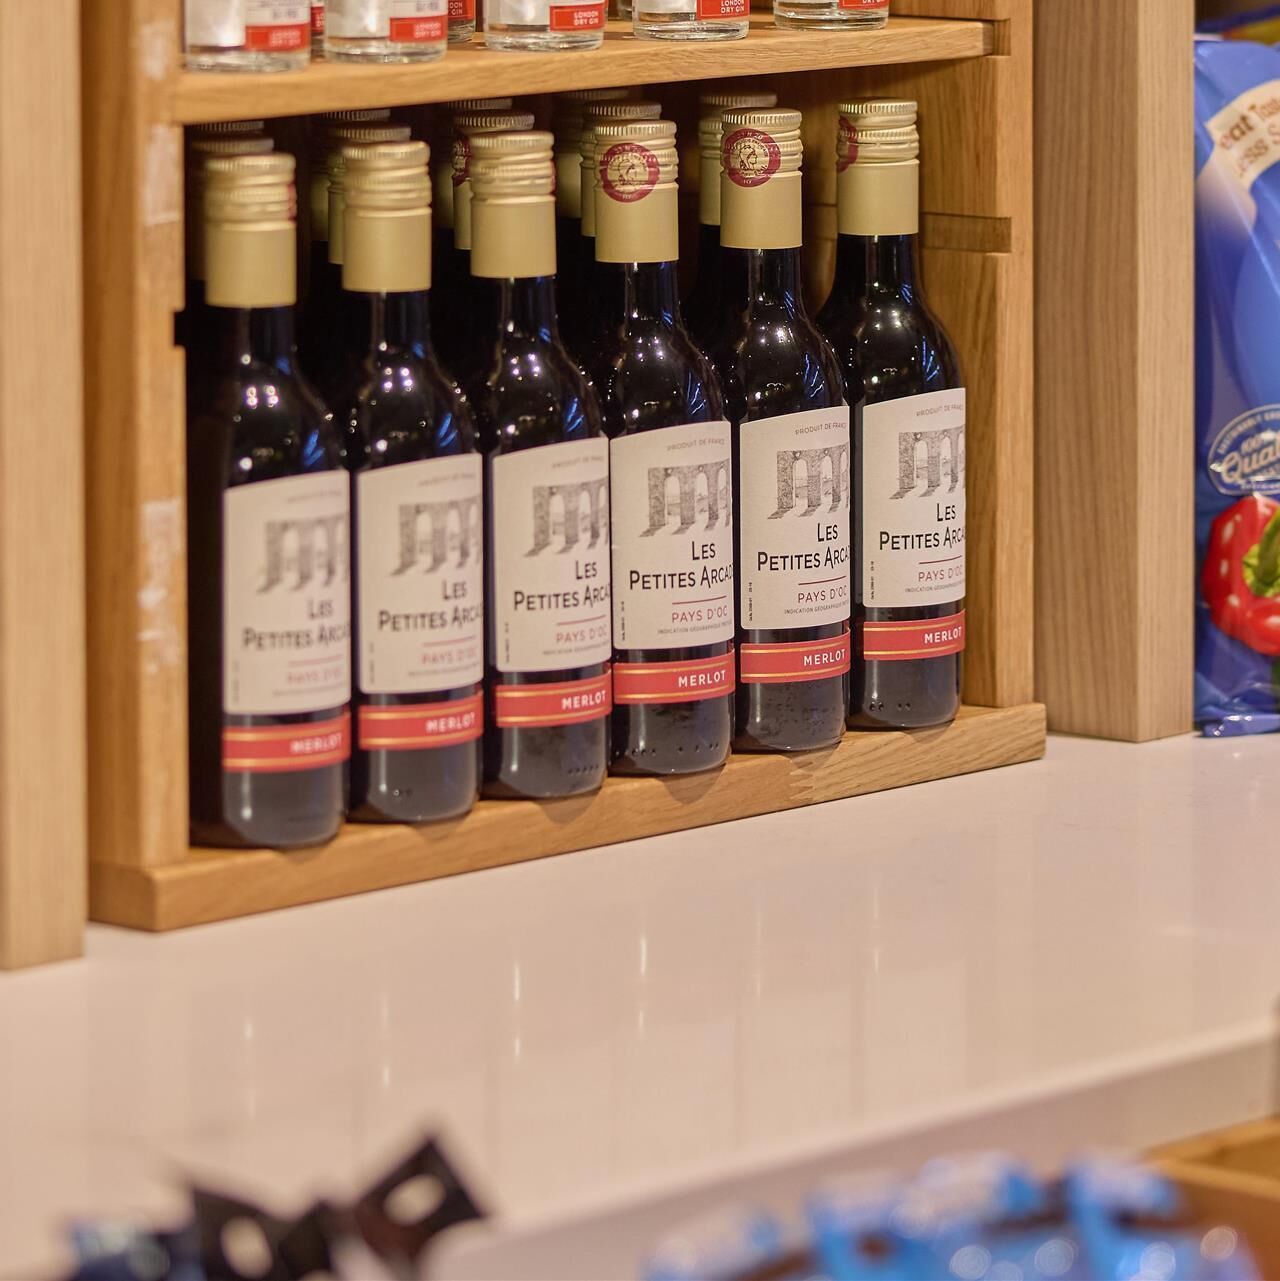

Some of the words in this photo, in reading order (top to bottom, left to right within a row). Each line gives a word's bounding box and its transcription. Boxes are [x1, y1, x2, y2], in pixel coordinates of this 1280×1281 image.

[721, 0, 744, 7] LONDON
[721, 6, 734, 14] DRY
[1220, 114, 1256, 150] eat
[795, 424, 823, 435] PRODUIT
[879, 530, 940, 551] PETITES
[758, 551, 820, 572] PETITES
[629, 570, 696, 591] PETITES
[918, 570, 945, 583] PAYS
[513, 589, 580, 611] PETITES
[797, 590, 826, 604] PAYS
[671, 609, 703, 623] PAYS
[707, 605, 728, 620] D'OC
[784, 607, 814, 615] INDICATION
[556, 631, 587, 645] PAYS
[924, 626, 962, 644] MERLOT
[803, 649, 845, 666] MERLOT
[678, 669, 726, 688] MERLOT
[561, 689, 607, 710] MERLOT
[426, 712, 476, 733] MERLOT
[290, 732, 343, 753] MERLOT
